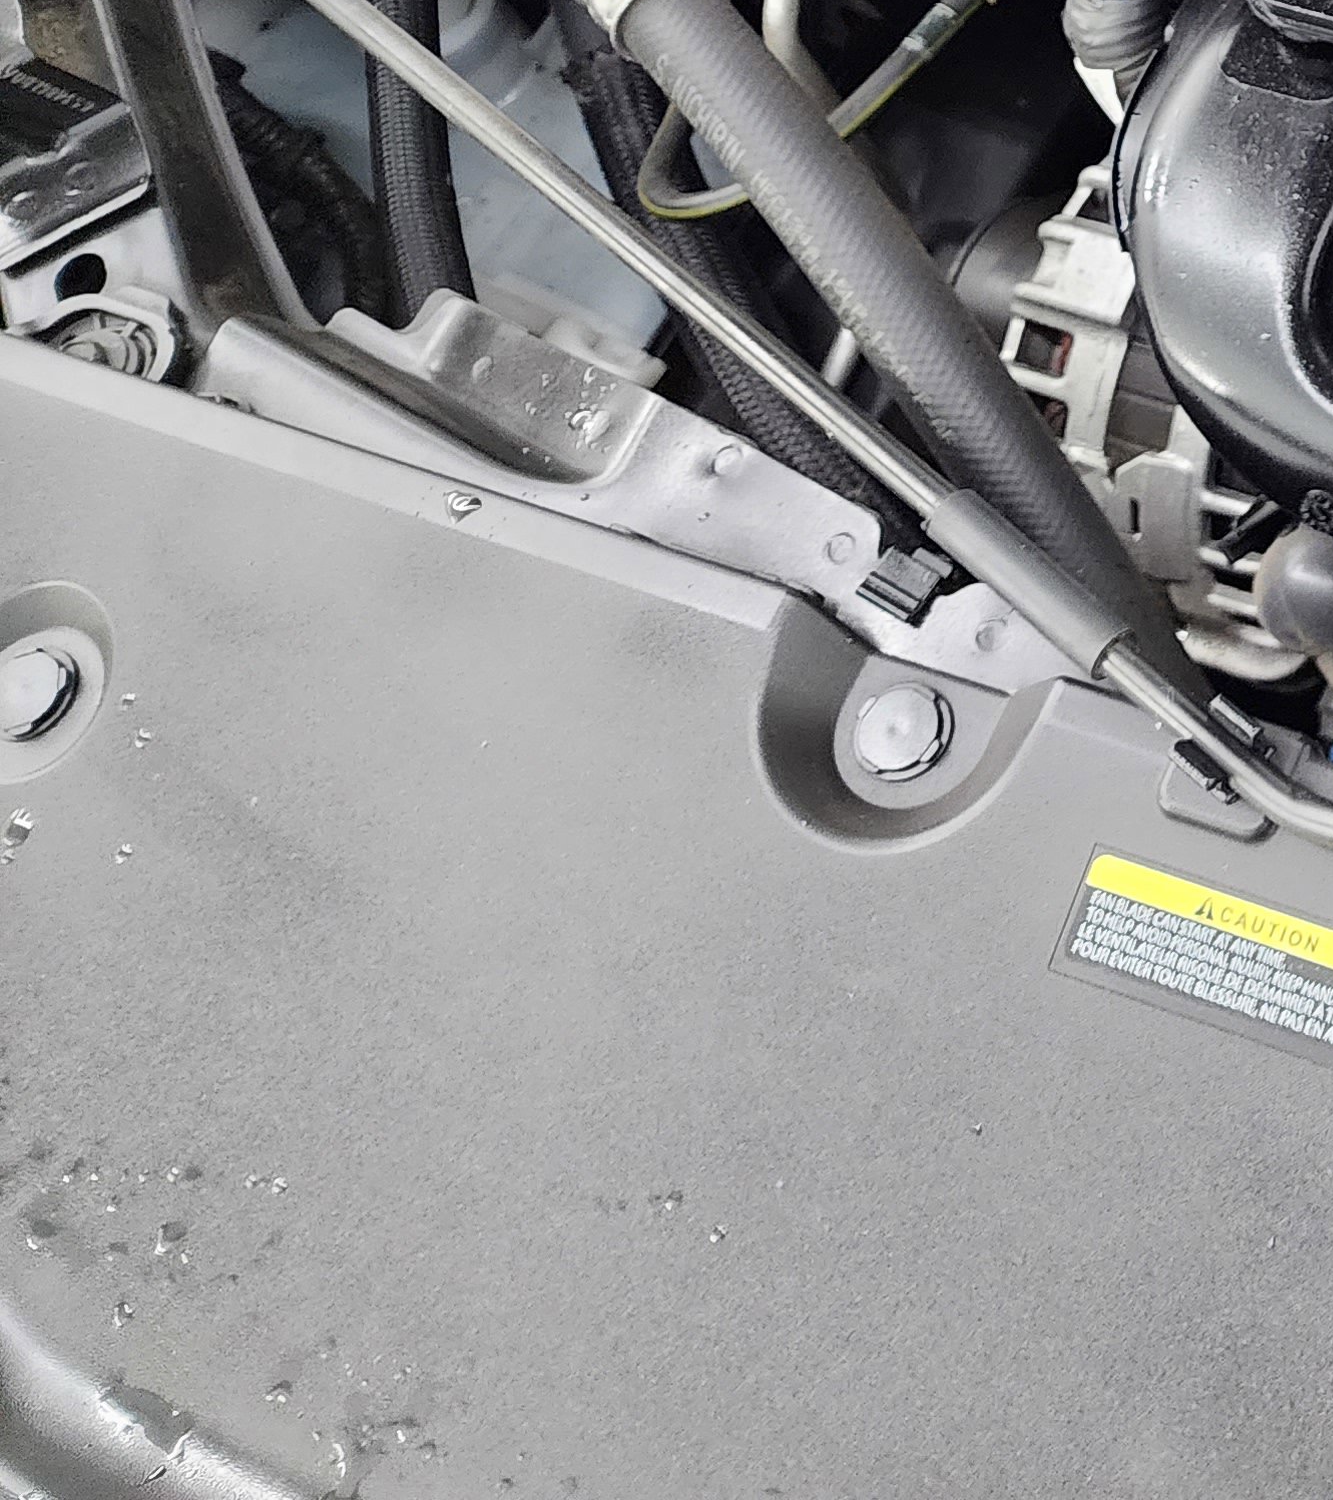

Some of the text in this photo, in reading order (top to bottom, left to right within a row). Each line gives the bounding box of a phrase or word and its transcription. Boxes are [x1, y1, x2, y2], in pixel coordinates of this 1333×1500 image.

[1077, 921, 1097, 940] LE
[1223, 971, 1245, 992] DE
[1086, 905, 1105, 924] TO
[1131, 922, 1172, 948] AVOID
[1089, 889, 1117, 913] FAN
[1152, 911, 1181, 933] CAN
[1178, 918, 1218, 943] START
[1230, 936, 1260, 960] ANY
[1220, 906, 1320, 952] CAUTION
[1071, 938, 1110, 965] POUR
[1151, 964, 1197, 995] TOUTE
[1257, 1001, 1281, 1025] NE
[1278, 1009, 1306, 1033] PAS
[1303, 1017, 1326, 1040] EN
